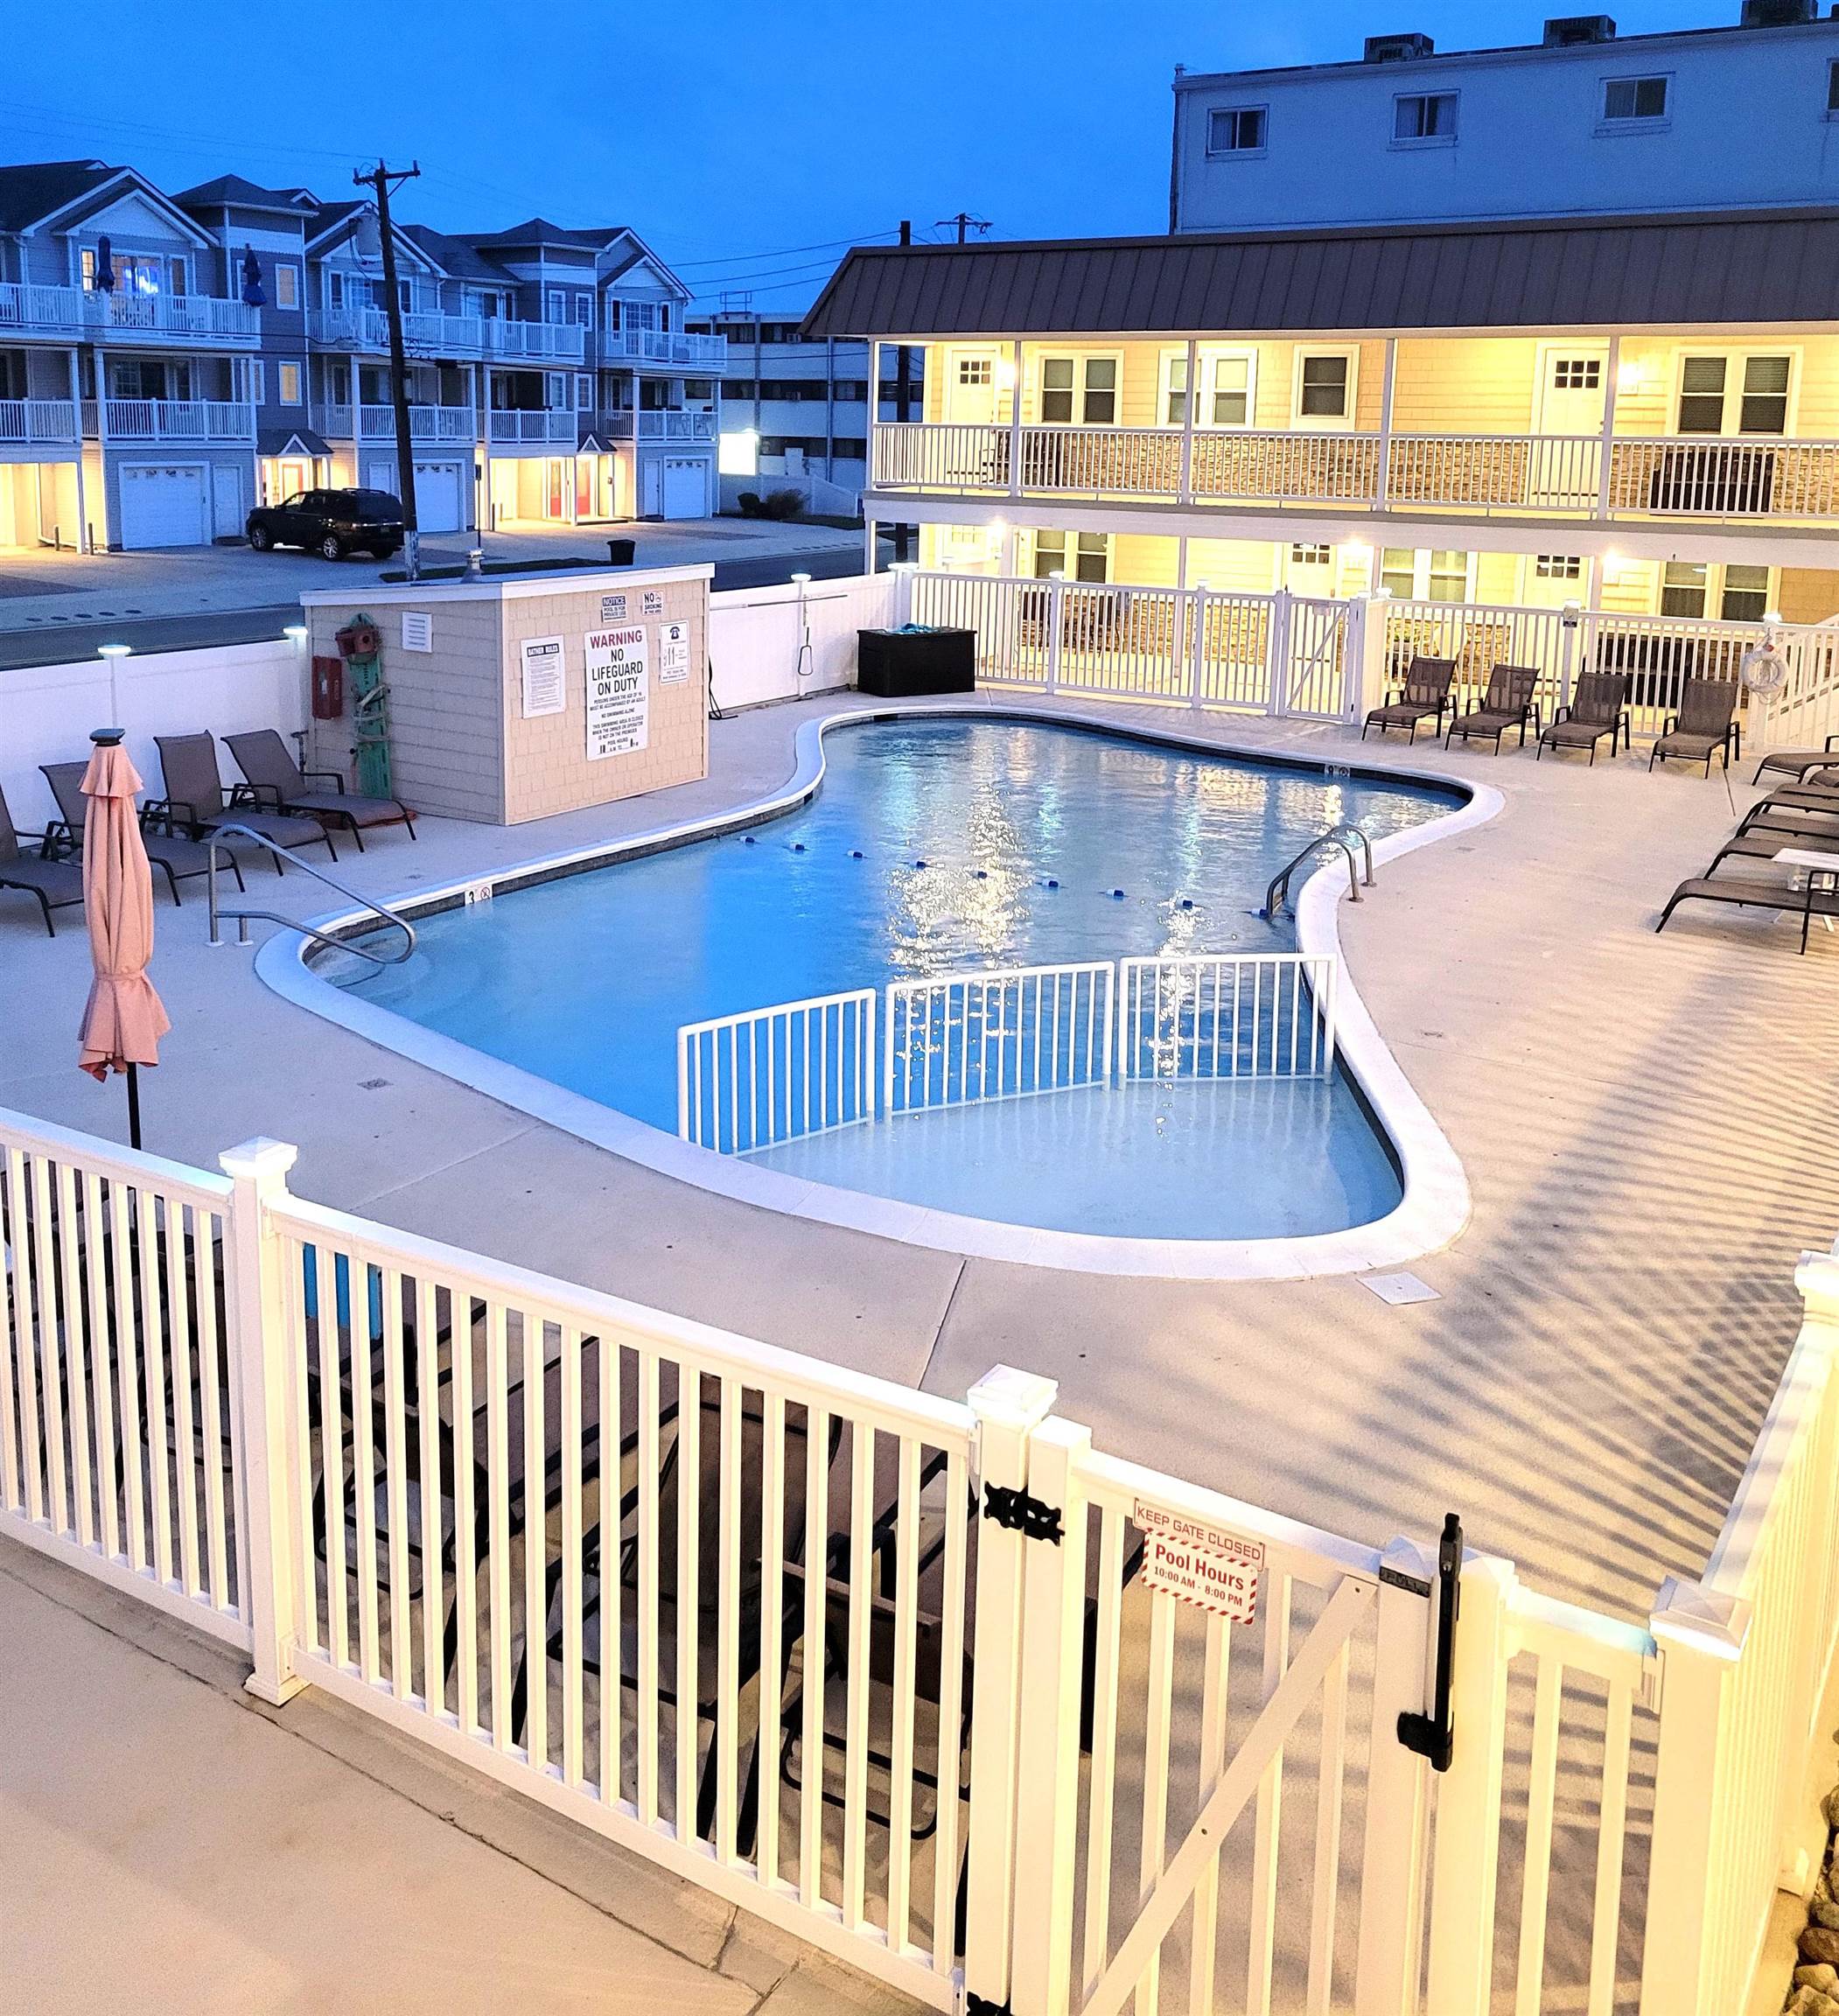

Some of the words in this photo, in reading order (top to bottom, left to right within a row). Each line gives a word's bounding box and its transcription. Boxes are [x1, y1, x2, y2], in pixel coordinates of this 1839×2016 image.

[603, 596, 625, 606] NOTICE
[644, 593, 654, 603] NO
[590, 630, 642, 649] WARNING
[611, 648, 624, 662] NO
[592, 661, 643, 681] LIFEGUARD
[598, 681, 611, 695] ON
[614, 677, 638, 693] DUTY
[469, 891, 474, 904] 3
[1137, 1506, 1169, 1526] KEEP
[1173, 1520, 1204, 1540] GATE
[1208, 1532, 1260, 1560] CLOSED
[1155, 1544, 1190, 1571] Pool
[1195, 1558, 1244, 1591] Hours
[1154, 1566, 1179, 1582] 10:00
[1181, 1578, 1195, 1589] AM
[1205, 1585, 1225, 1600] 8:00
[1228, 1594, 1242, 1606] PM
